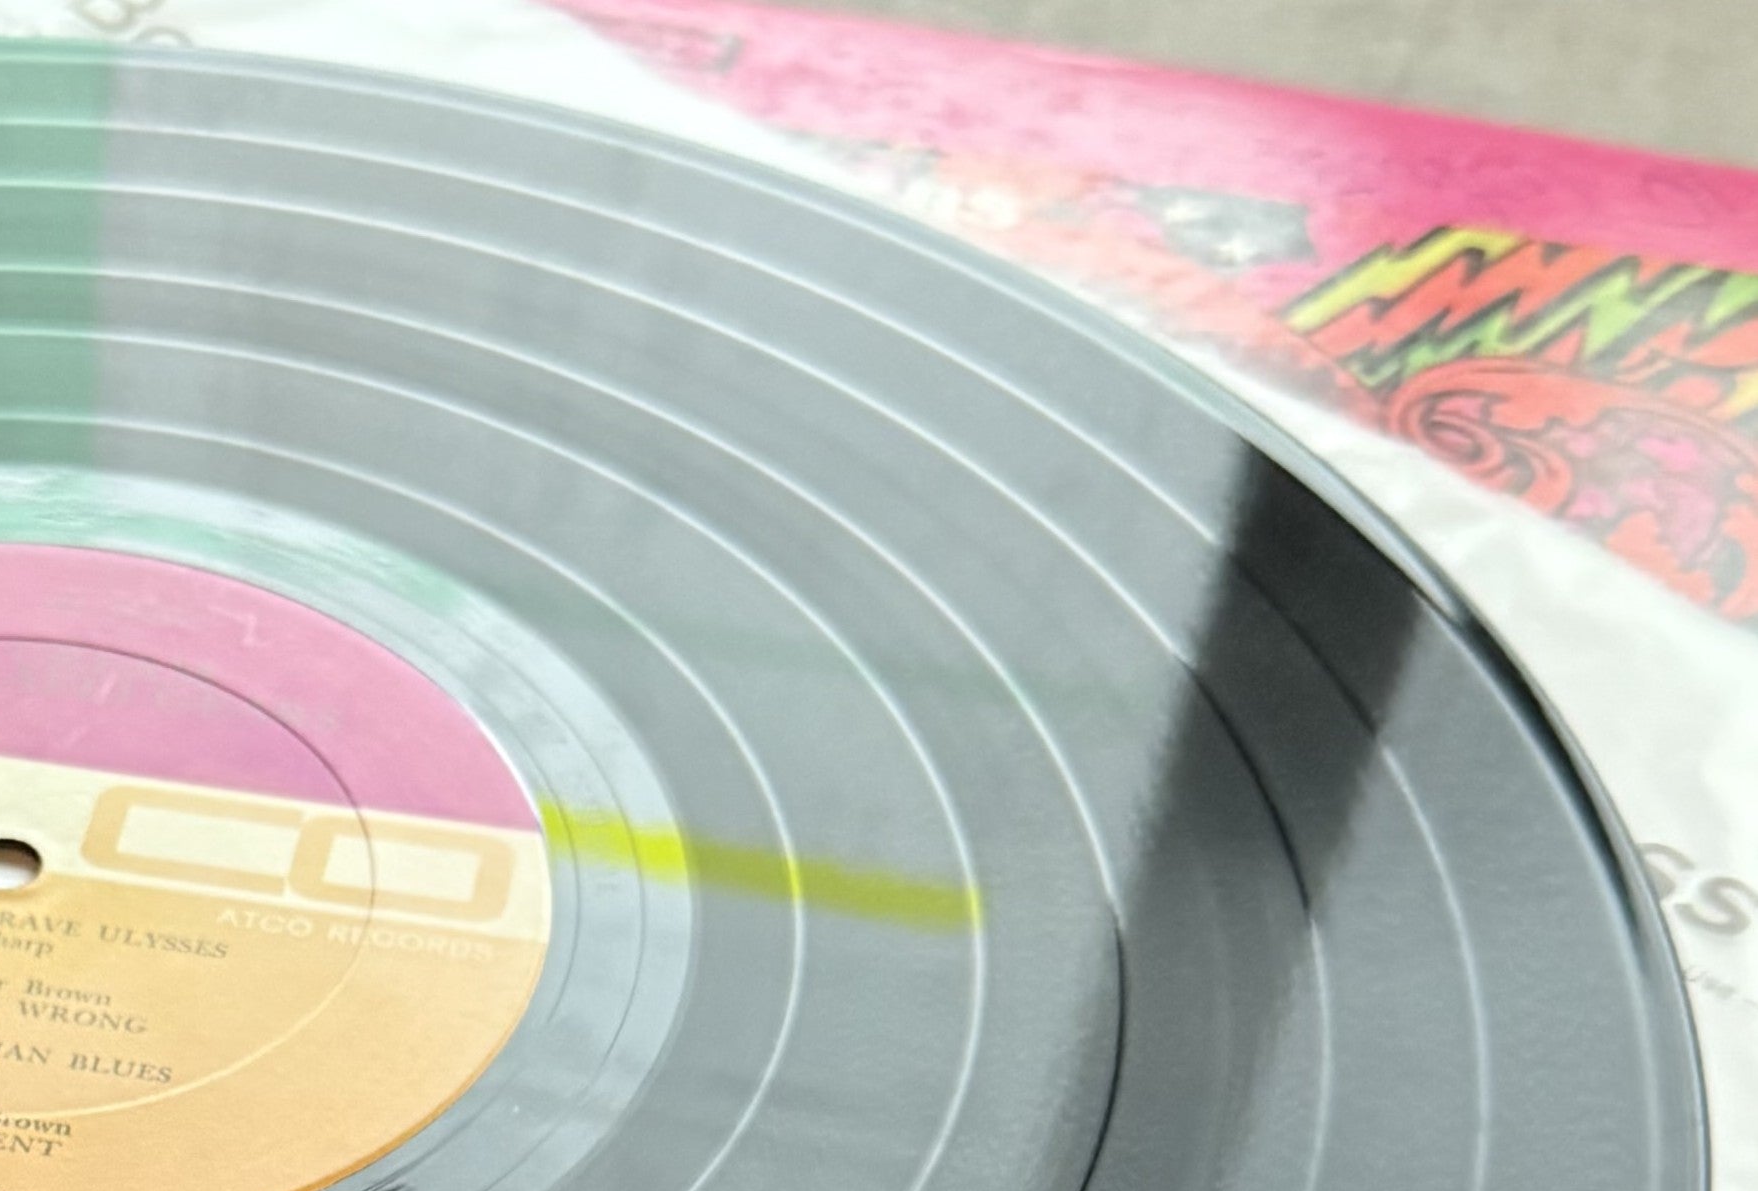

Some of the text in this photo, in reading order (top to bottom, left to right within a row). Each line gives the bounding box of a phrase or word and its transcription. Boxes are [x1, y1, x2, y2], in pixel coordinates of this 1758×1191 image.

[98, 923, 229, 960] ULYSSES
[216, 908, 494, 962] ATCO RECORDS
[24, 978, 112, 1007] Brown
[17, 999, 148, 1034] WRONG
[68, 1052, 173, 1085] BLUES
